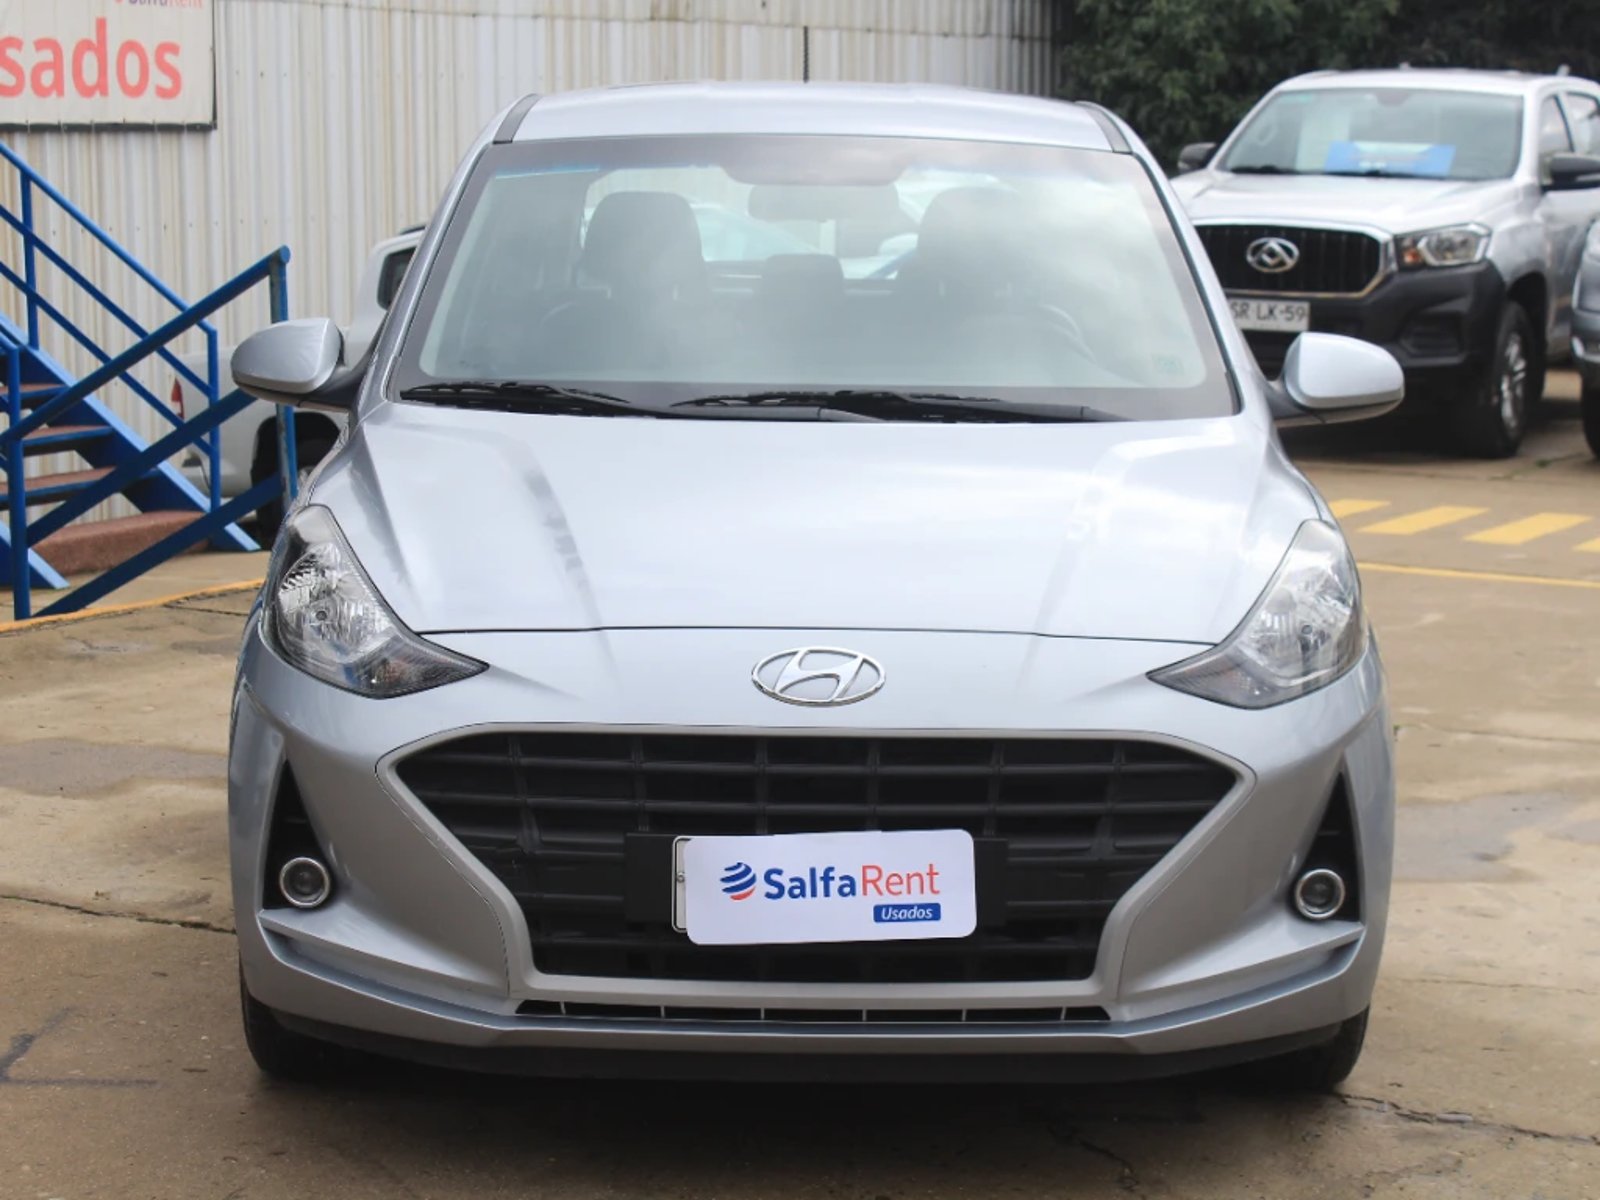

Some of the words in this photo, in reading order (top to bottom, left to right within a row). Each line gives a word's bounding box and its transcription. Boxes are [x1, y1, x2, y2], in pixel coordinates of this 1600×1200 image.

[0, 17, 182, 99] sados
[763, 863, 941, 900] SalfaRent
[881, 906, 933, 921] Usados
